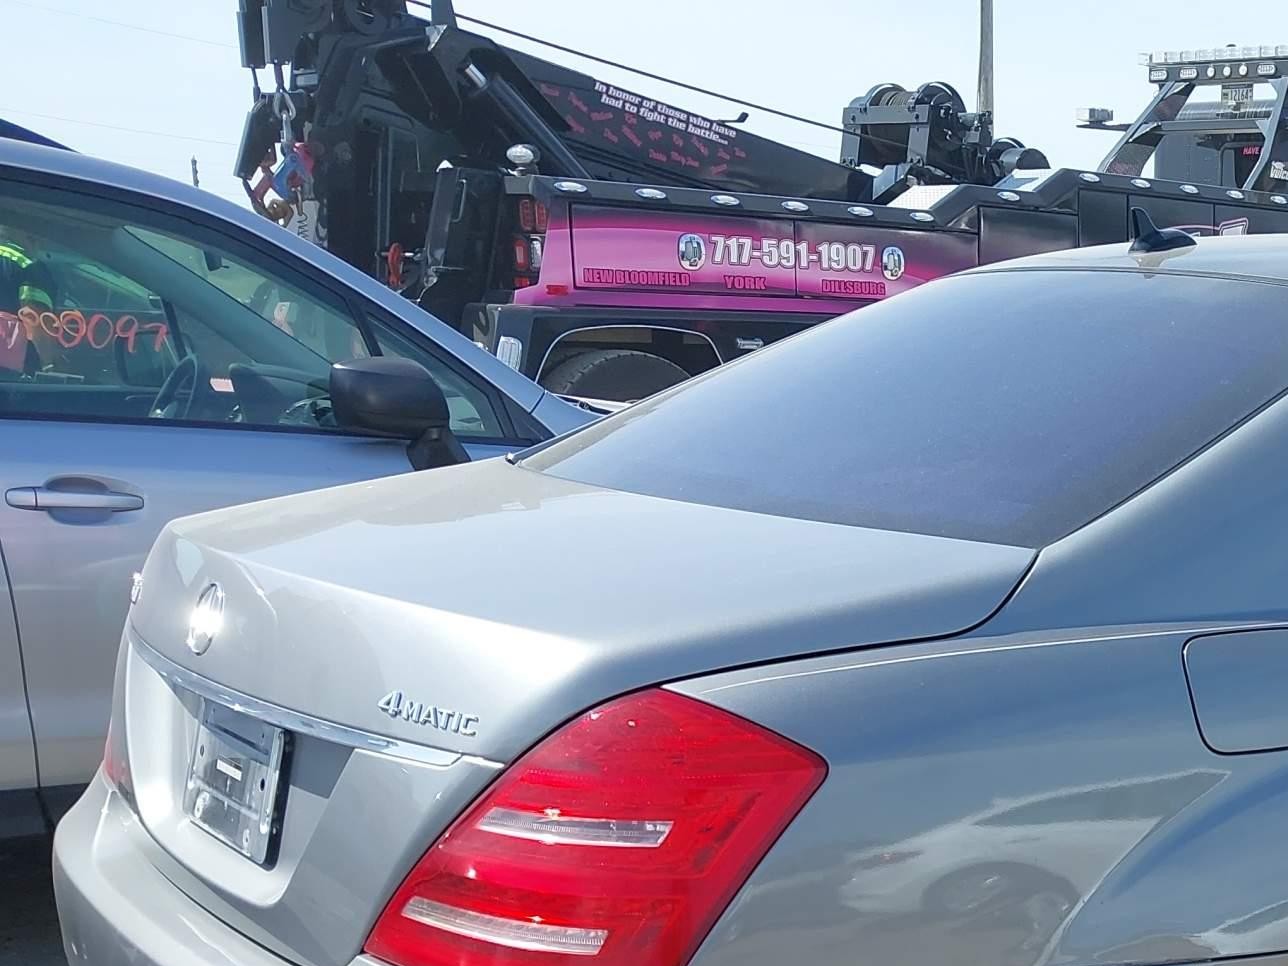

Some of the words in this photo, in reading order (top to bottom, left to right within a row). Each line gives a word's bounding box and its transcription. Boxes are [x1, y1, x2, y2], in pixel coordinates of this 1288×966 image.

[594, 81, 607, 93] In
[608, 86, 642, 105] honor
[642, 97, 656, 110] of
[657, 101, 688, 121] those
[689, 112, 711, 129] who
[712, 120, 737, 138] have
[601, 93, 623, 109] had
[624, 101, 638, 114] to
[638, 107, 667, 125] fight
[667, 115, 687, 131] the
[1243, 146, 1260, 155] HAVE
[710, 234, 876, 272] 717-591-1907
[583, 268, 614, 284] NEW
[615, 269, 690, 286] BLOOMFIELD
[724, 275, 766, 290] YORK
[821, 279, 886, 295] DILLSBURG
[377, 690, 479, 736] 4MATIC
